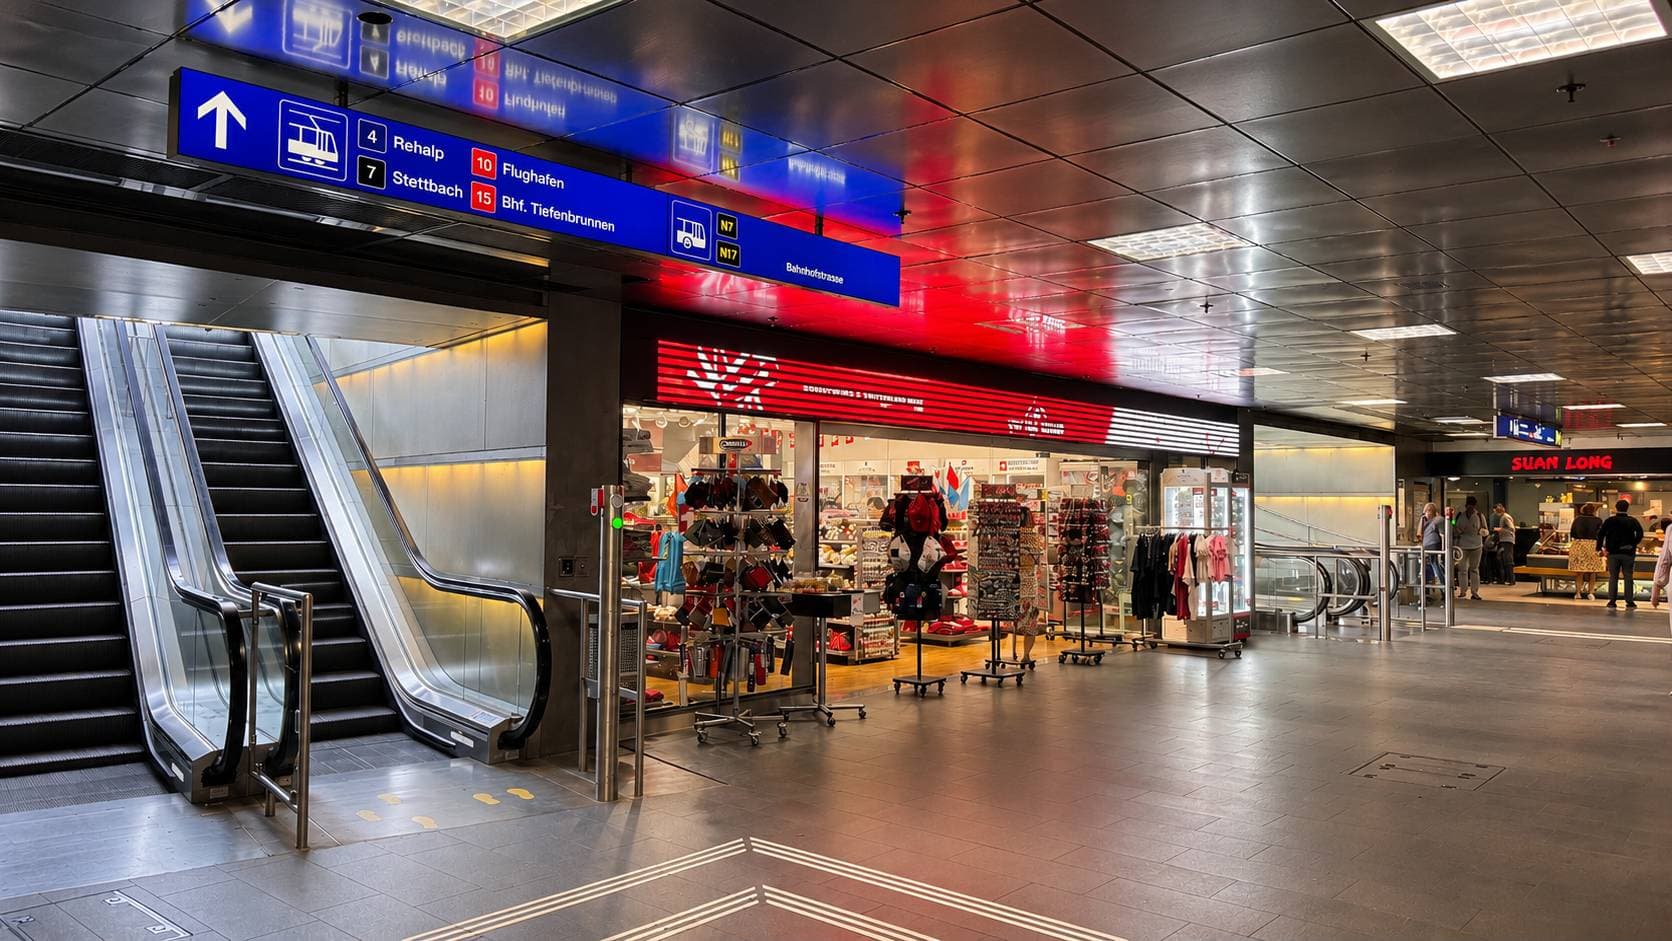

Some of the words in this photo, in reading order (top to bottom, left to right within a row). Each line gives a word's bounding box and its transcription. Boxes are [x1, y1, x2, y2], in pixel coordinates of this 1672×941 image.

[367, 130, 377, 144] 4
[393, 135, 444, 162] Rehalp
[366, 164, 376, 179] 7
[392, 170, 463, 198] Stettbach
[477, 157, 492, 172] 10
[503, 162, 565, 190] Flughafen
[477, 191, 492, 205] 15
[502, 195, 527, 213] Bhf.
[530, 201, 615, 232] Tiefenbrunnen
[720, 220, 734, 232] N7
[720, 247, 738, 261] N17
[786, 262, 844, 284] Bahnhofstrasse
[1511, 455, 1559, 471] SUAN
[1565, 455, 1613, 471] LONG
